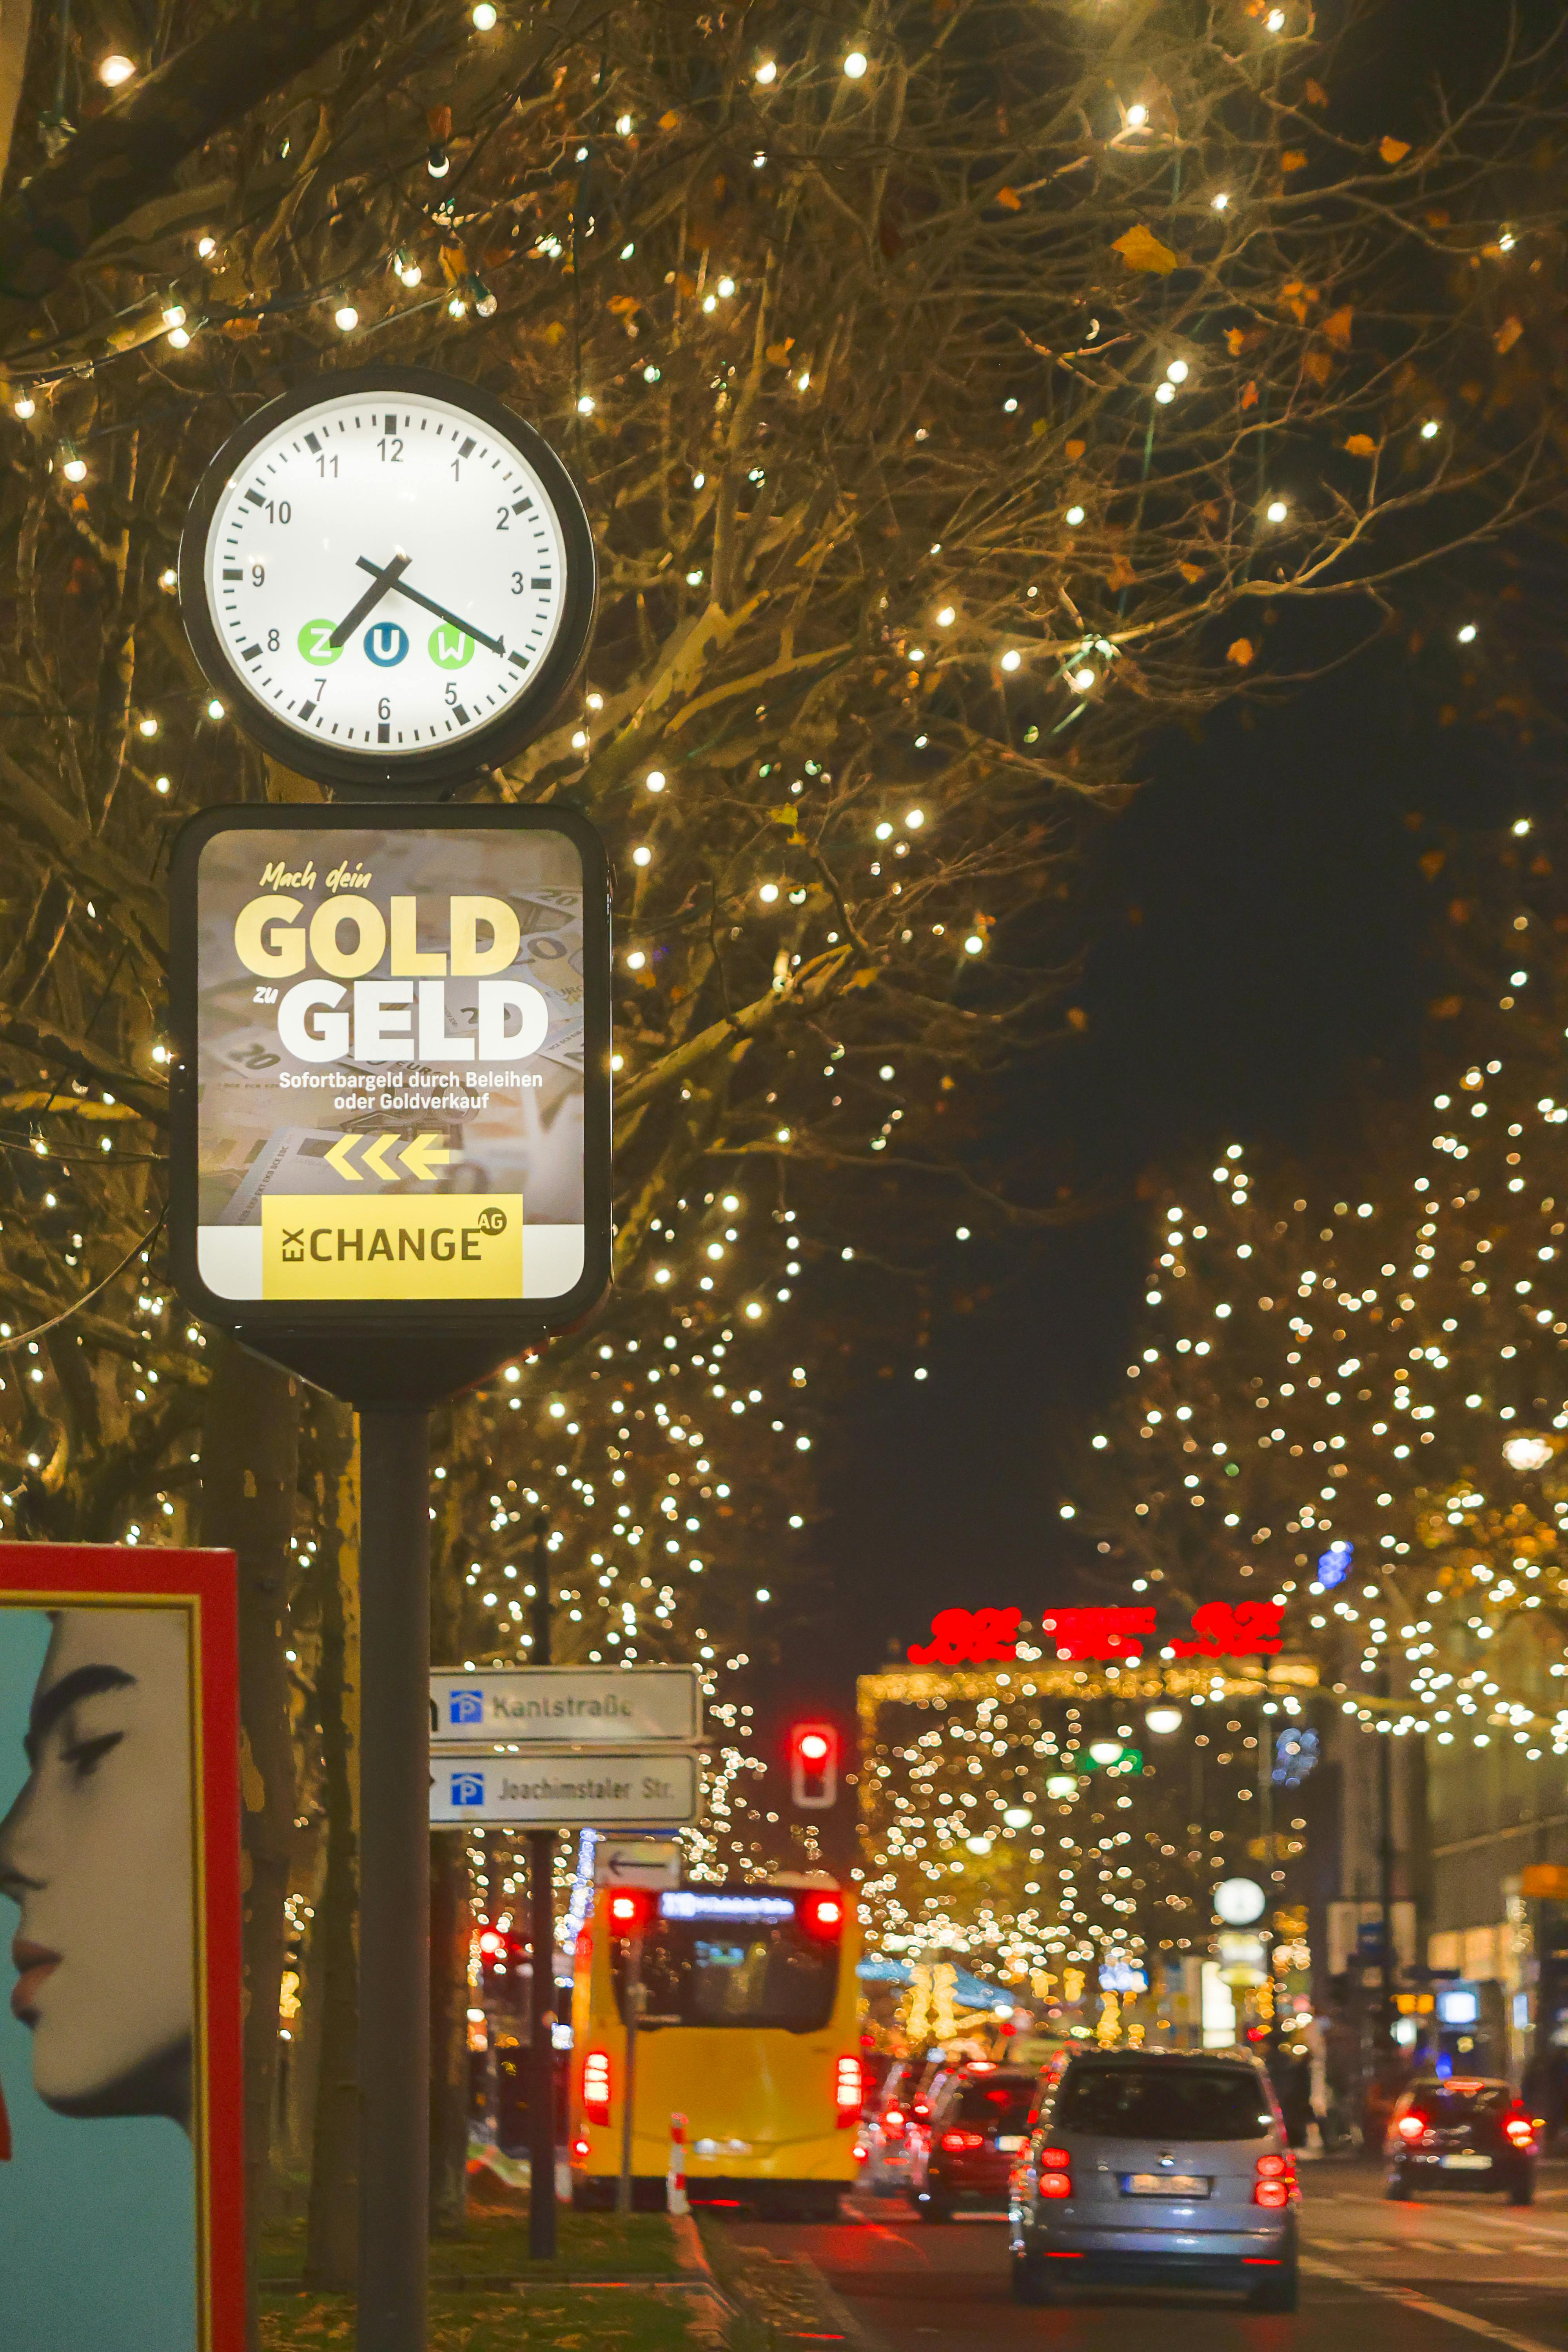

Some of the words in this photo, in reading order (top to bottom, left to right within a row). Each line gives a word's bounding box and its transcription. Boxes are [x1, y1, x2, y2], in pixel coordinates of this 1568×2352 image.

[377, 439, 404, 462] 12
[316, 454, 338, 478] 11
[450, 459, 460, 482] 1
[265, 501, 291, 524] 10
[496, 507, 509, 530] 2
[252, 566, 265, 587] 9
[511, 572, 523, 595] 3
[268, 629, 280, 652] 8
[310, 628, 332, 657] Z
[374, 629, 399, 660] U
[437, 631, 465, 662] W
[314, 679, 327, 701] 7
[445, 683, 457, 705] 5
[378, 698, 390, 720] 6
[259, 861, 316, 890] Mach
[325, 860, 372, 893] dein
[235, 895, 520, 978] GOLD
[253, 986, 278, 1004] zu
[278, 979, 548, 1063] GELD
[227, 1043, 281, 1070] 20
[279, 1071, 403, 1091] Sofortbargeld
[409, 1071, 459, 1087] durch
[466, 1071, 543, 1087] Beleihen
[334, 1093, 375, 1109] oder
[380, 1093, 489, 1109] Goldverkauf
[283, 1229, 304, 1262] EX
[310, 1228, 481, 1261] CHANGE
[478, 1214, 503, 1229] AG
